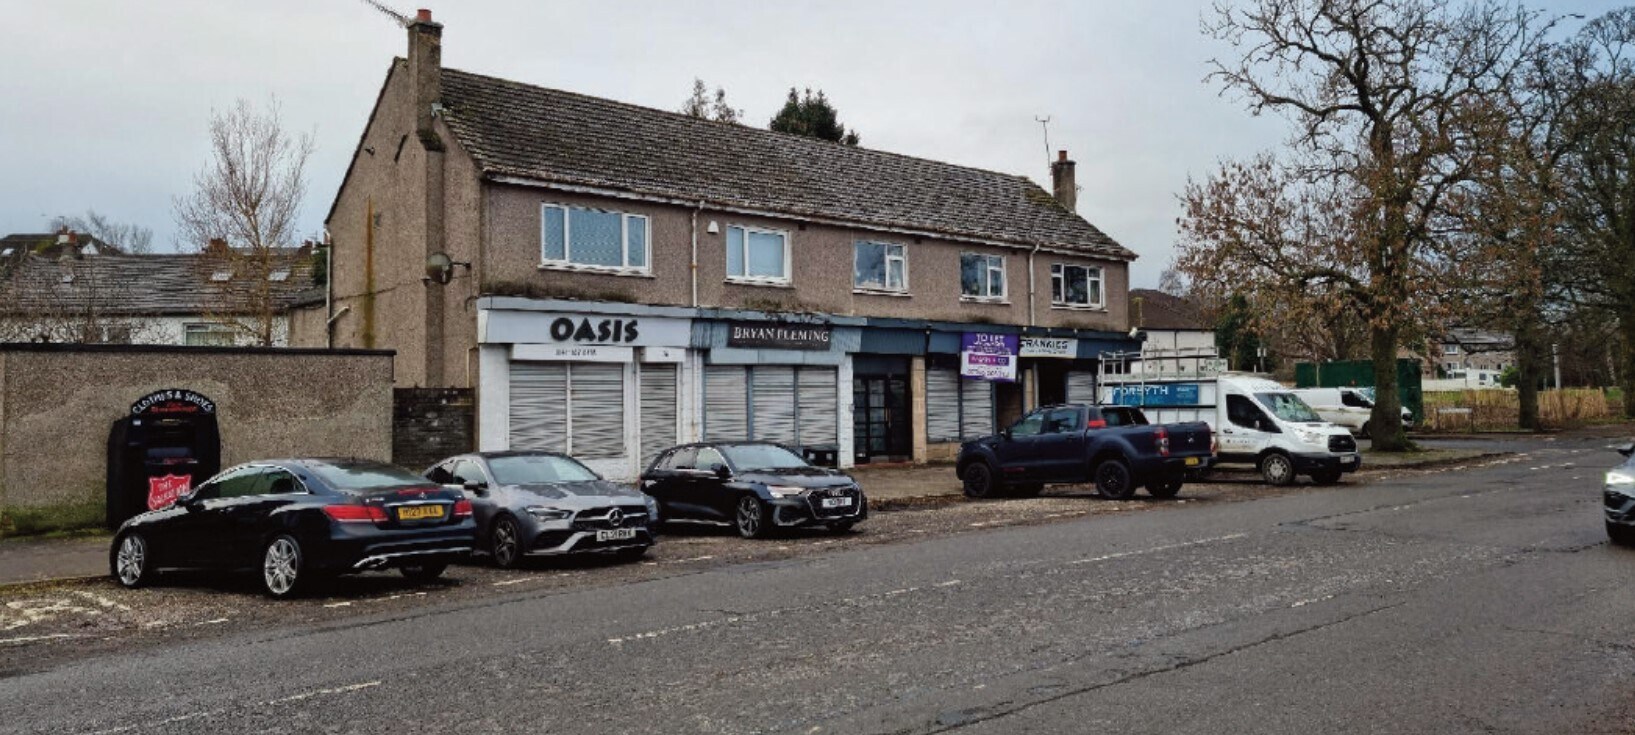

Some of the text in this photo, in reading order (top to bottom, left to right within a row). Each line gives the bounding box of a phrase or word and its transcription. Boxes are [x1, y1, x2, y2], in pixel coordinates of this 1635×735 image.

[550, 317, 638, 342] OASIS
[733, 326, 829, 342] BRYAN FLEMING
[975, 333, 1005, 343] TO LET
[1021, 339, 1068, 350] FRANKIES
[1113, 385, 1168, 396] FORSYTH
[132, 390, 173, 414] CLOTHES
[174, 390, 182, 400] &
[185, 392, 214, 412] SHOES
[157, 480, 173, 490] THE
